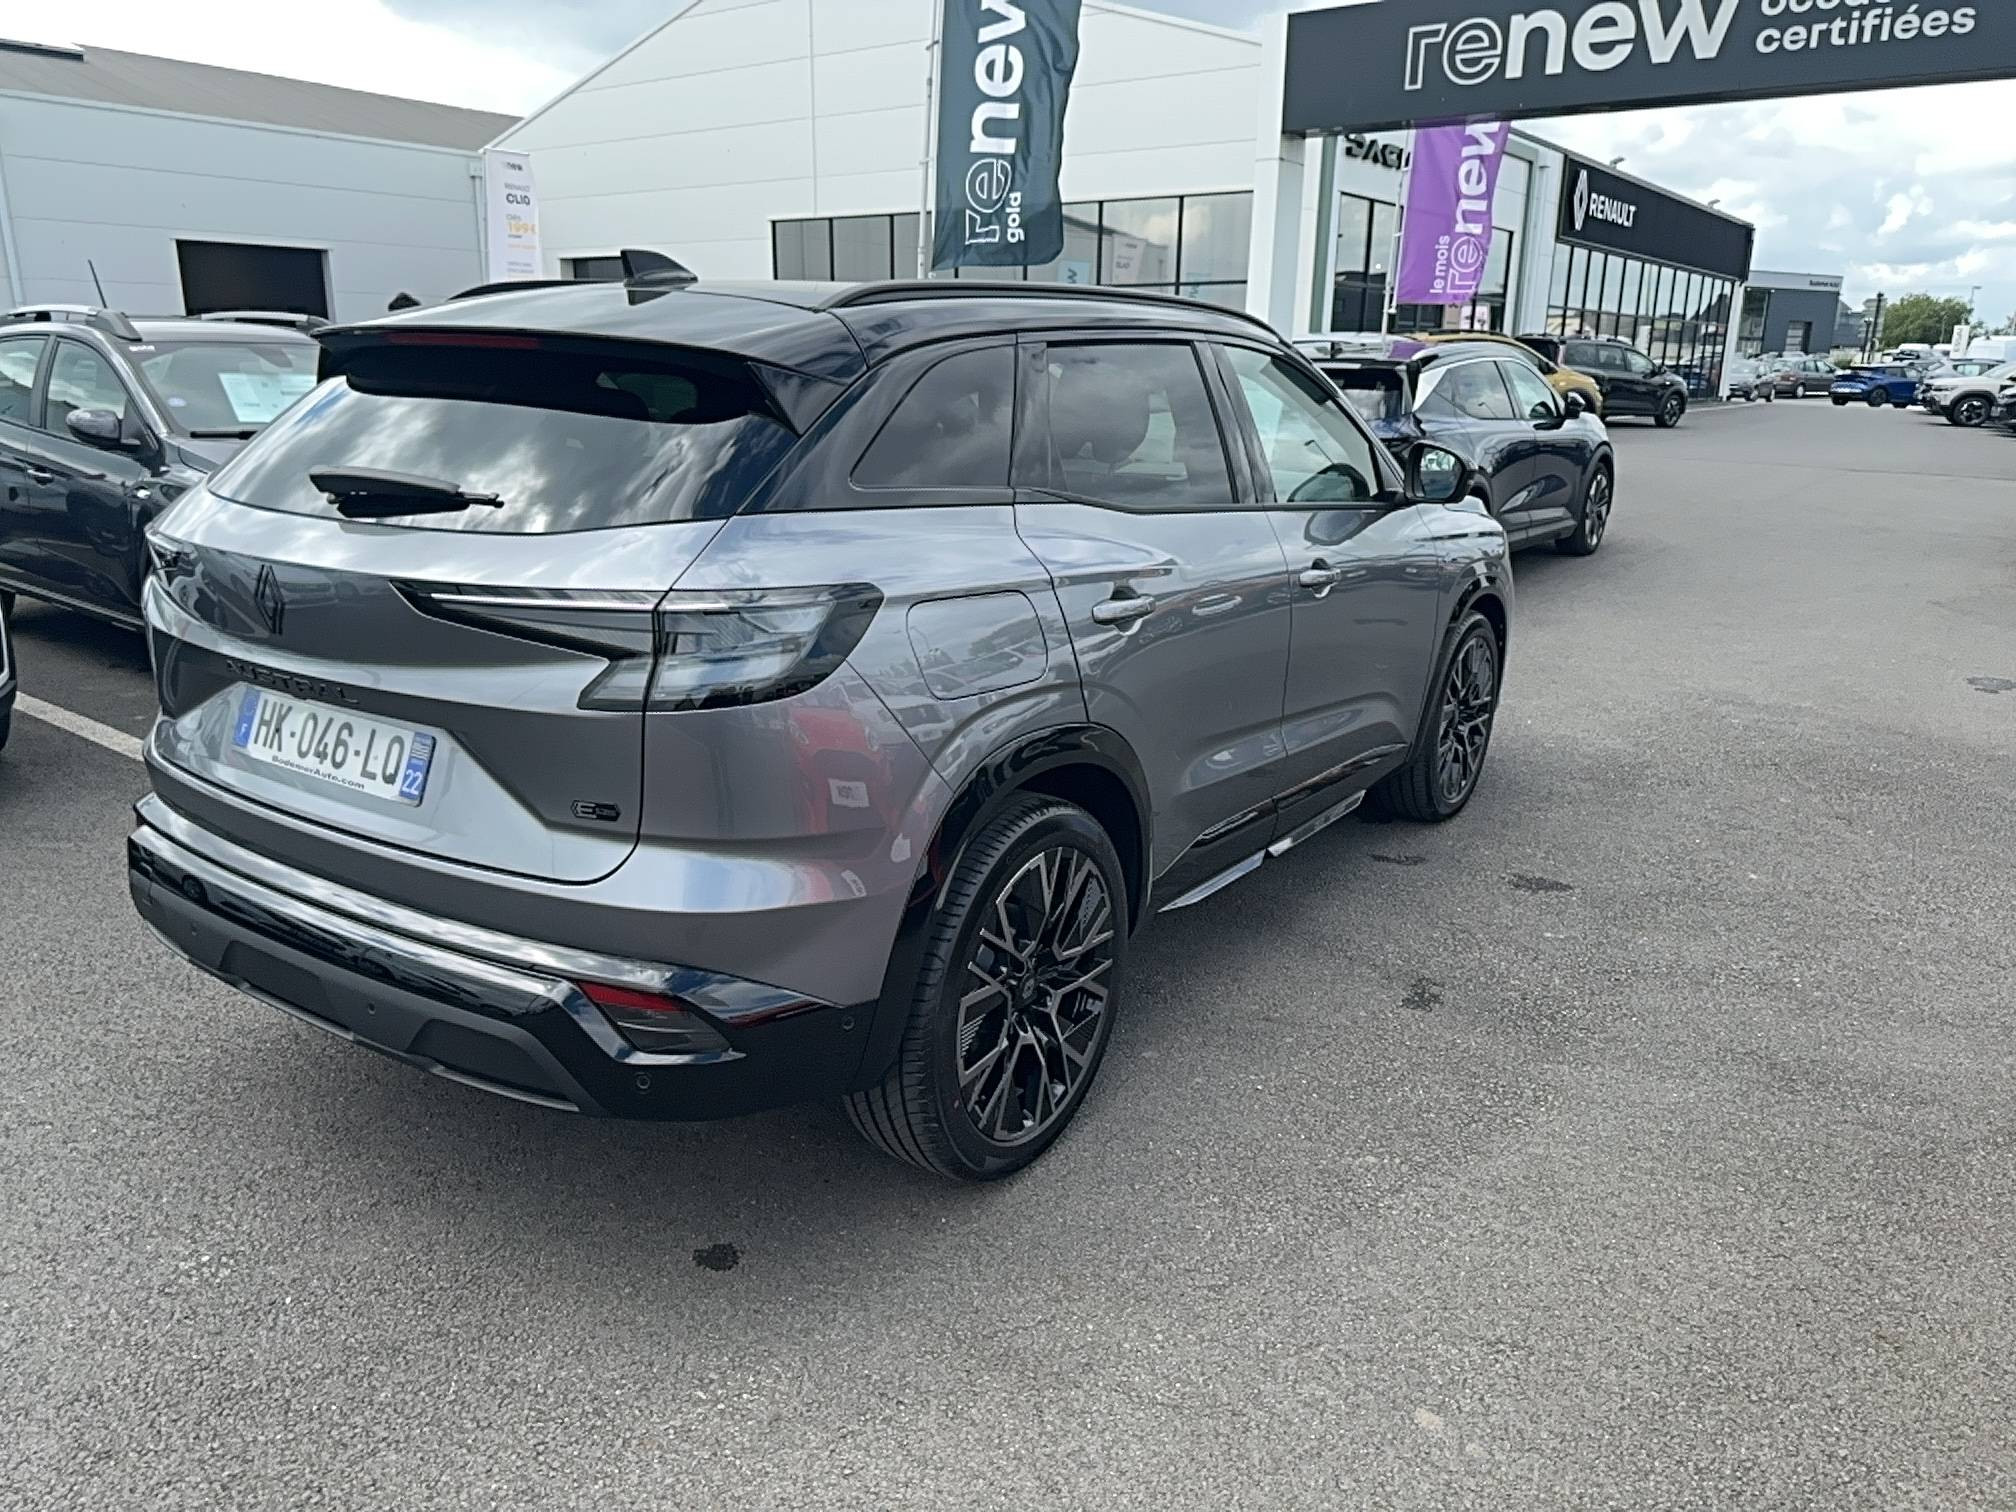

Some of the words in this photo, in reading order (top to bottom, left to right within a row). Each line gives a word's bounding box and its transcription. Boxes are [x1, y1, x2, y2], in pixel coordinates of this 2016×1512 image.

[1404, 0, 1740, 91] renew
[1755, 4, 1977, 54] certifiées
[505, 193, 531, 206] CLIO
[1005, 192, 1025, 244] gold
[1589, 192, 1637, 228] RENAULT
[1434, 235, 1450, 276] mois
[1430, 279, 1444, 294] le
[254, 699, 406, 786] HK-046-LQ
[402, 769, 422, 796] 22
